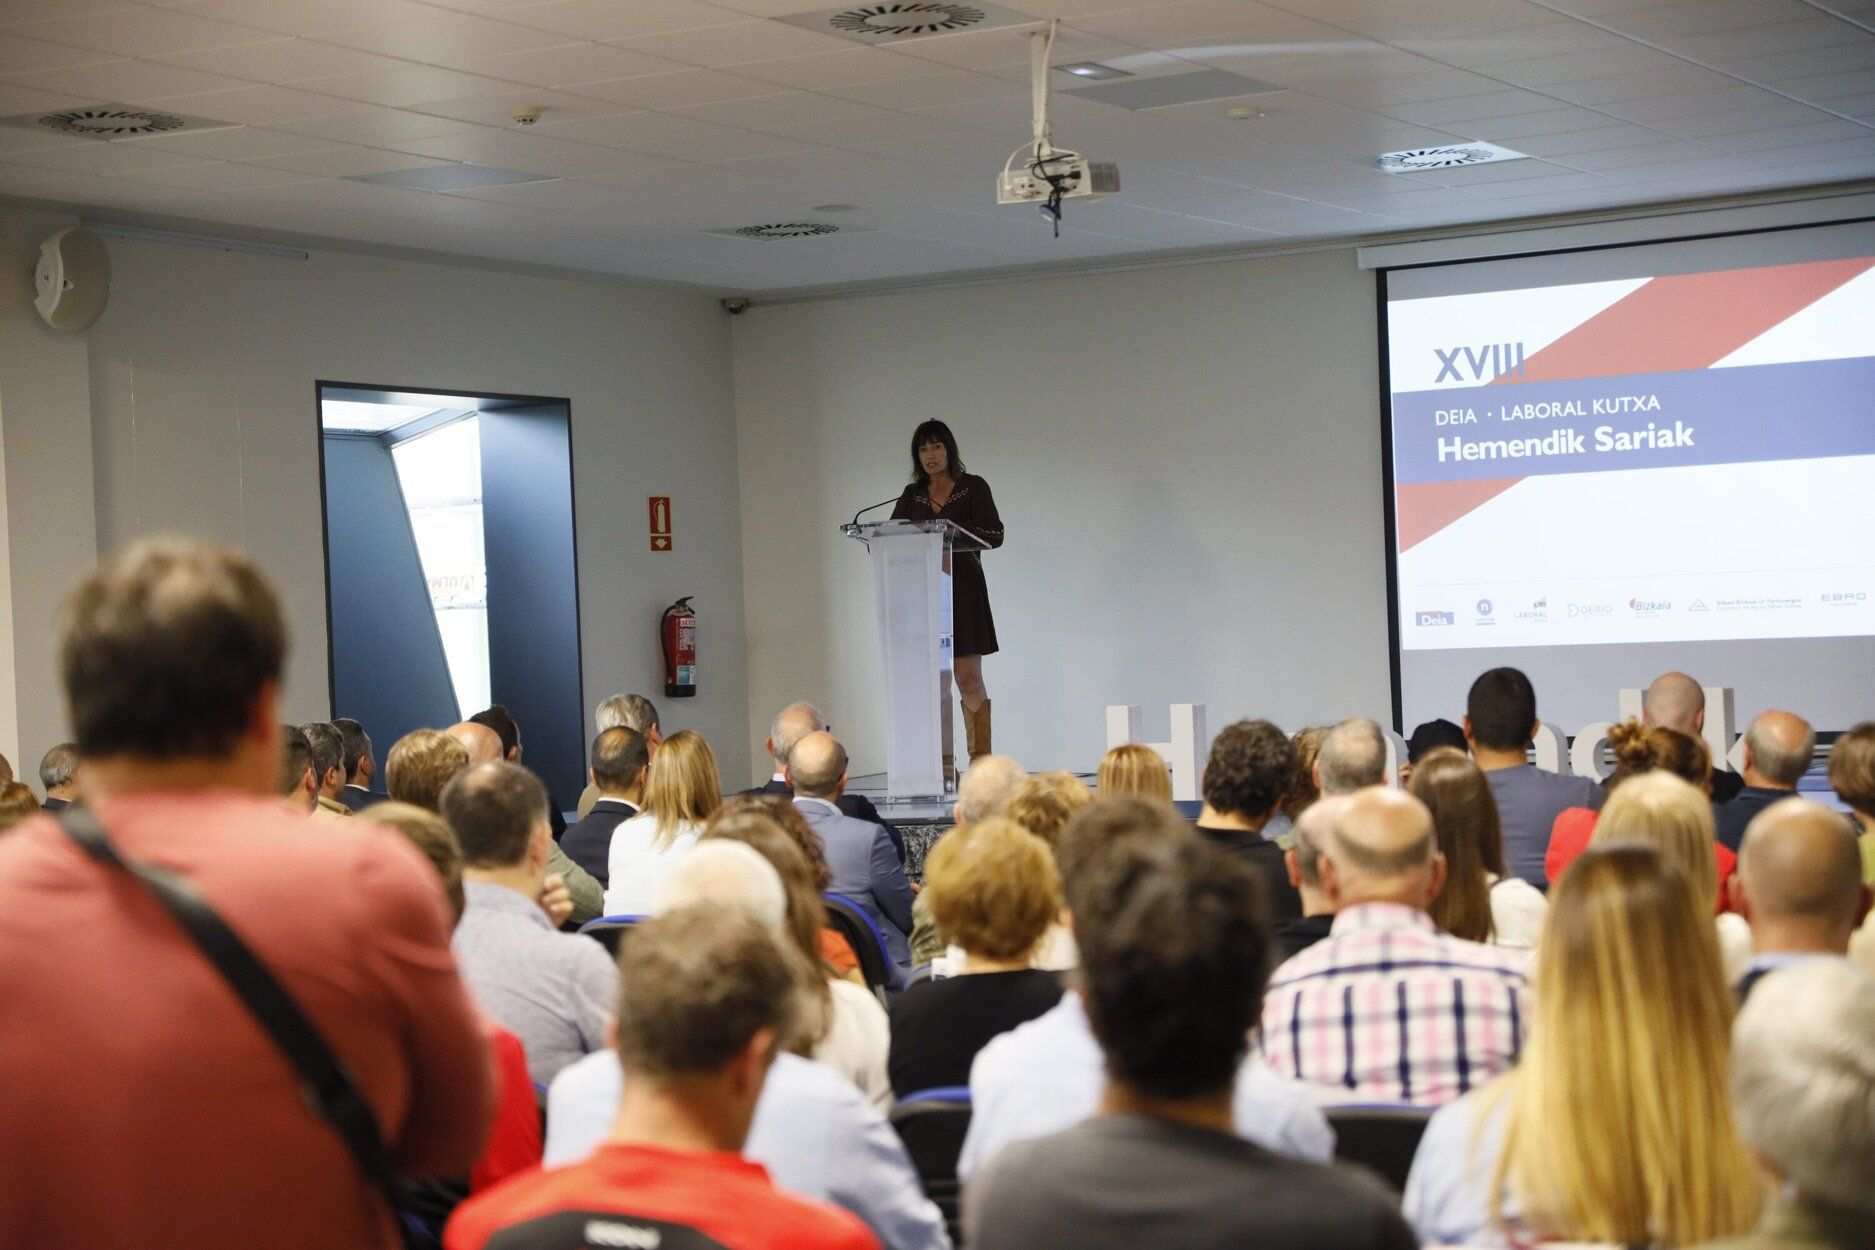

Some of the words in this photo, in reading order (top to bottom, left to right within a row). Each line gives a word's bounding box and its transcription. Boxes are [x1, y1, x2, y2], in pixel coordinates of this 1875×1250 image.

[1434, 342, 1525, 383] XVIII
[1435, 409, 1477, 427] DEIA
[1501, 401, 1586, 422] LABORAL
[1592, 395, 1660, 414] KUTXA
[1437, 429, 1585, 462] Hemendik
[1594, 421, 1695, 452] Sariak
[1821, 592, 1867, 602] EBRO
[1580, 604, 1613, 615] DERIO
[1635, 600, 1671, 612] Bizkaia
[1421, 614, 1447, 626] Deia
